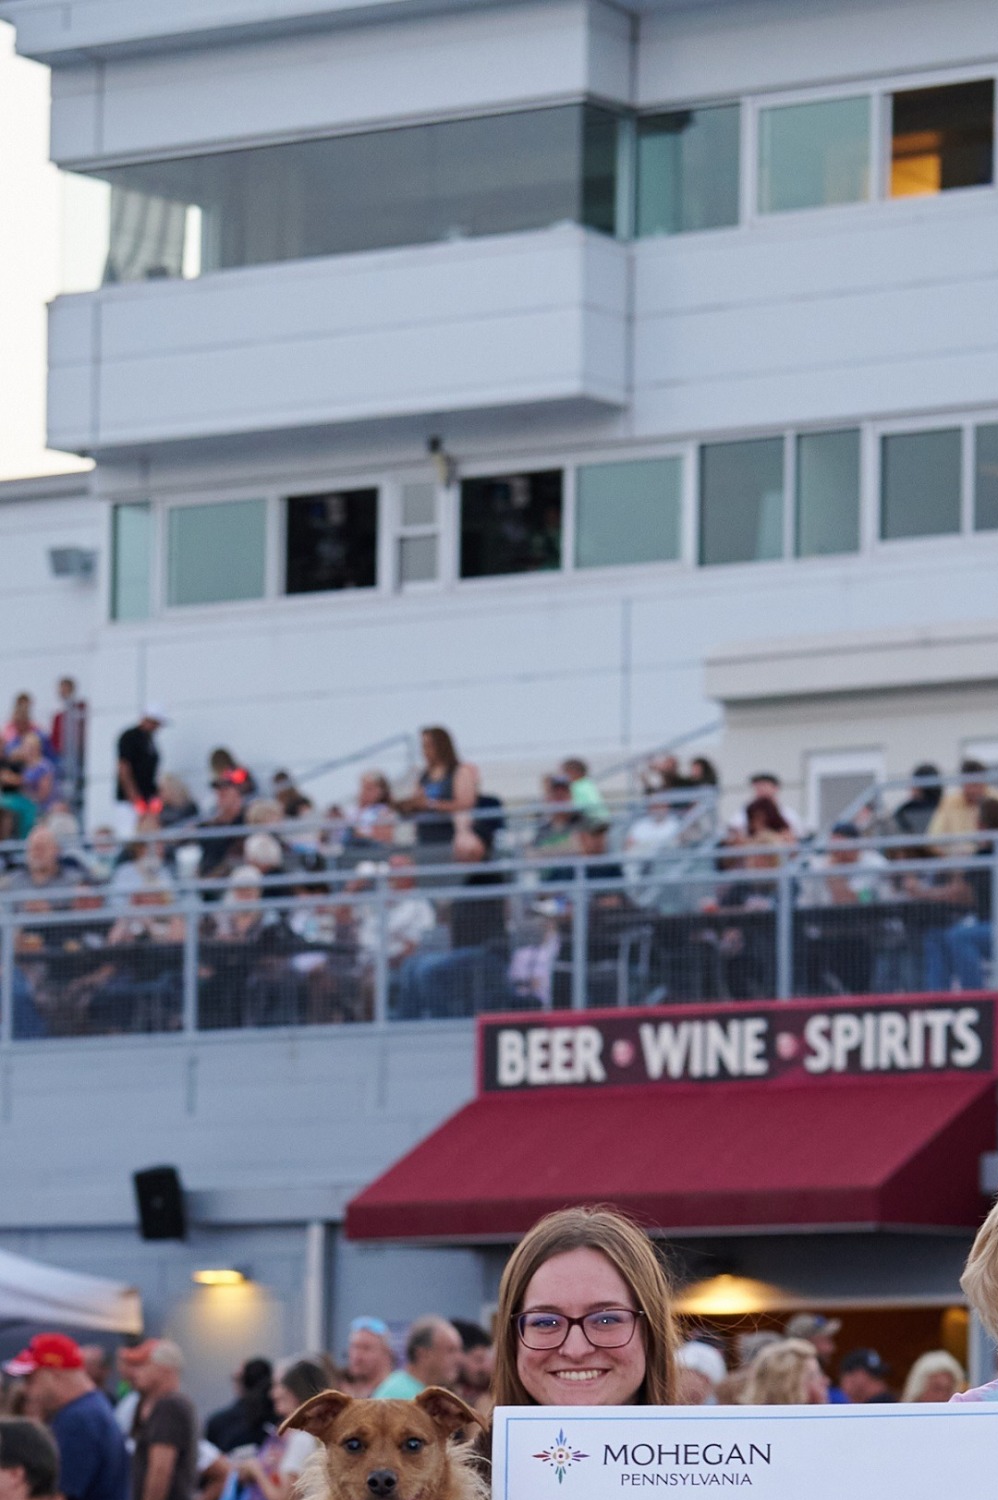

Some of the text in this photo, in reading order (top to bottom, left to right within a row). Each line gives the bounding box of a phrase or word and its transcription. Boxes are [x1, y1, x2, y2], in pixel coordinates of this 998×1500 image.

[498, 1008, 982, 1086] BEER WINE SPIRITS
[603, 1443, 772, 1466] MOHEGAN
[620, 1472, 753, 1486] PENNSYLVANIA
